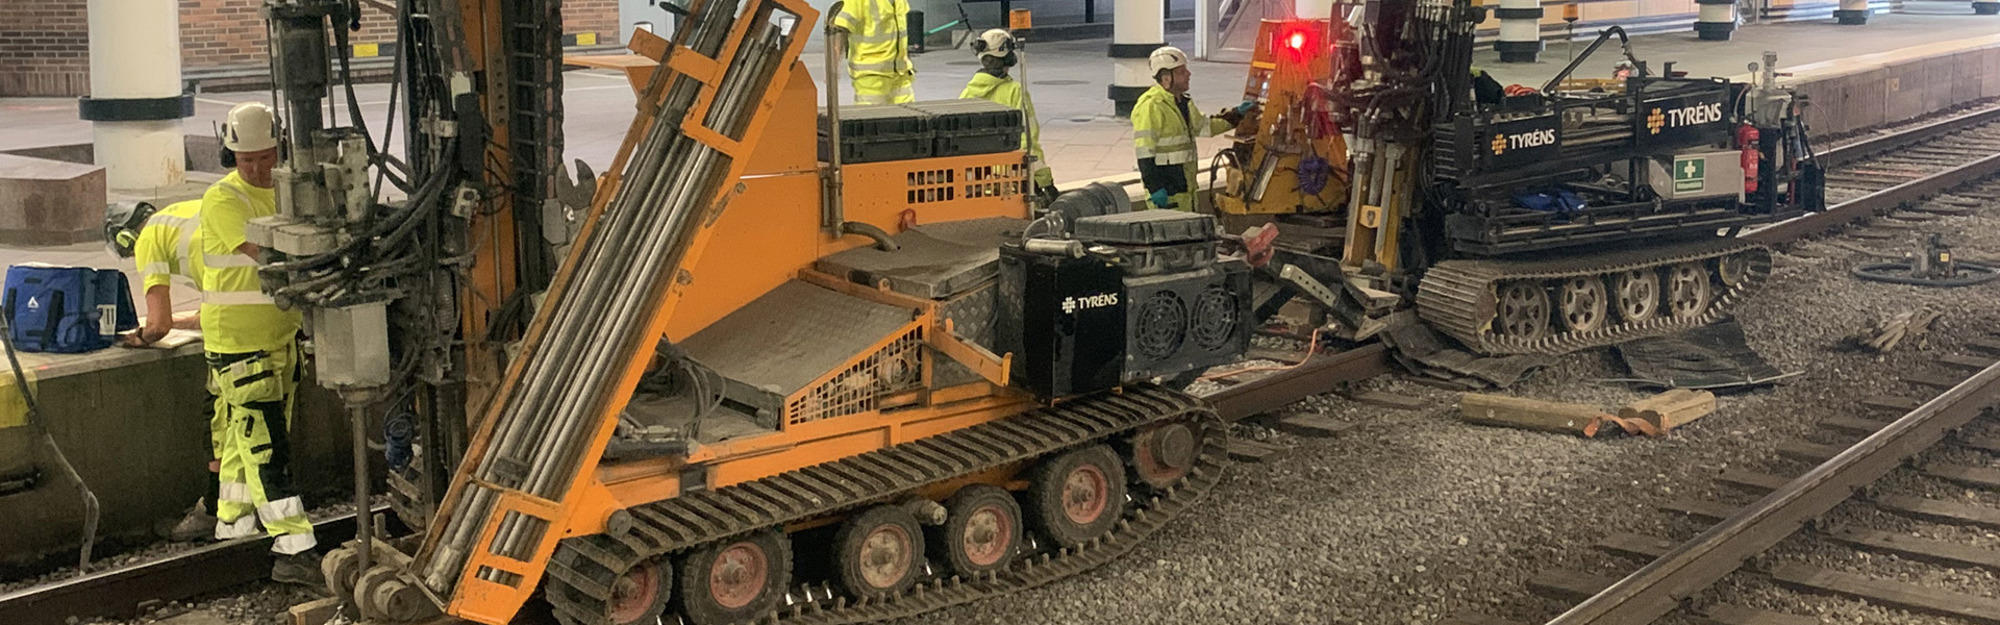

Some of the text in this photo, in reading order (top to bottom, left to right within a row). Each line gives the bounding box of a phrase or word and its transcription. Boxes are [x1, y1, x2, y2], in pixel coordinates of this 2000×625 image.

[1668, 102, 1722, 127] TYRÉNS
[1509, 128, 1555, 149] TYRÉNS
[1078, 293, 1118, 309] TYRÉNS
